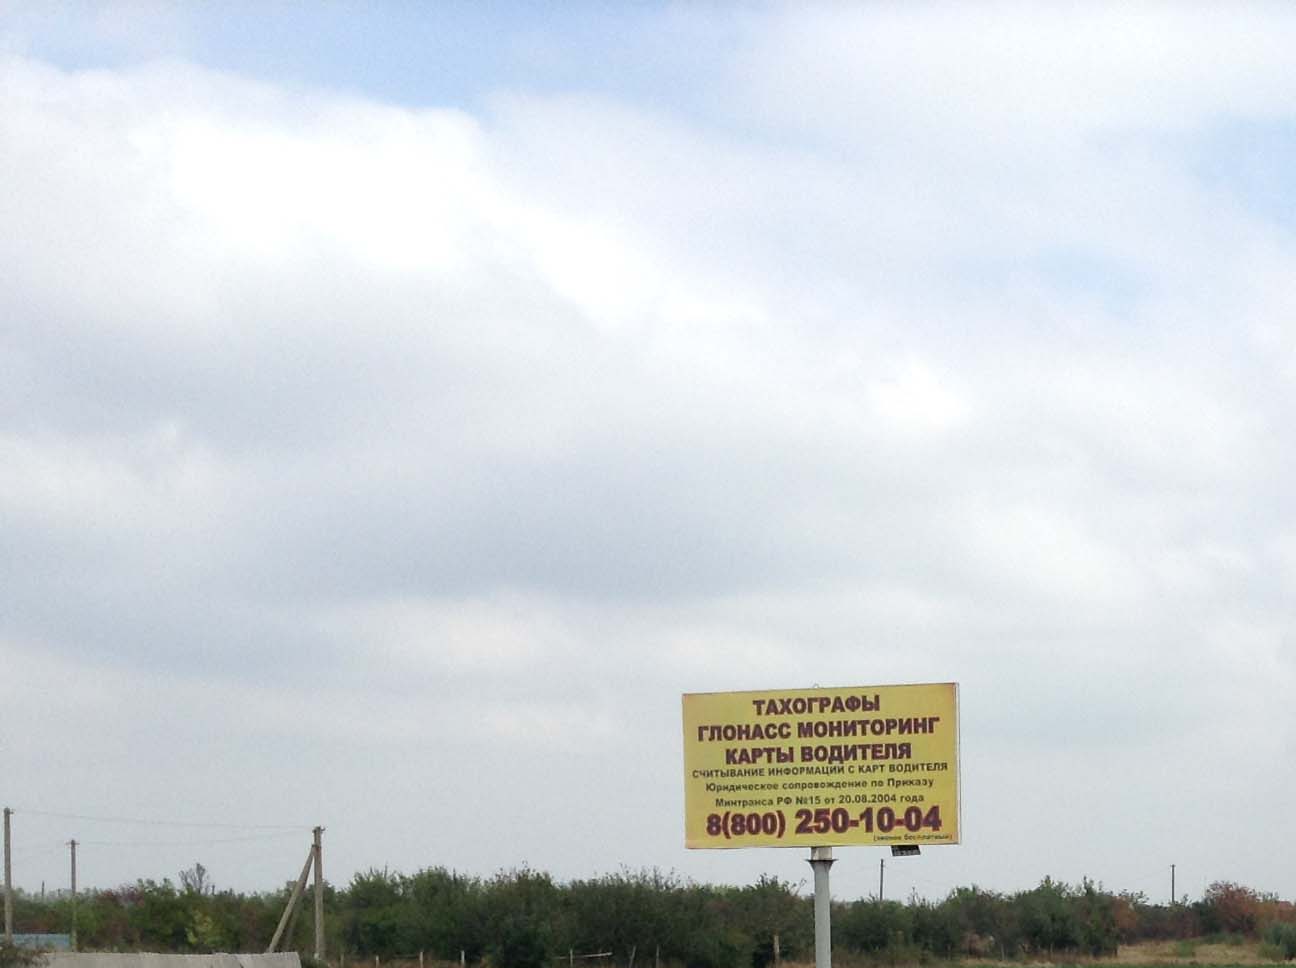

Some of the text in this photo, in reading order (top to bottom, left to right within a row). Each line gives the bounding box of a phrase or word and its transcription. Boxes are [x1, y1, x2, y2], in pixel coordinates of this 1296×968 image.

[753, 695, 880, 716] ТАХОГРАФЫ
[698, 717, 940, 742] ГЛОНАСС МОНИТОРИНГ
[726, 743, 912, 765] КАРТЫ ВОДИТЕЛЯ
[692, 762, 948, 779] СЧИТЫВАНИЕ ИНФОРМАЦИИ С КАРТ ВОДИТЕЛЯ
[705, 777, 934, 793] Юридическое сопровождение по Приказу
[715, 798, 774, 809] Минтранса
[777, 796, 793, 807] РФ
[796, 795, 821, 806] №15
[824, 795, 836, 804] от
[899, 793, 925, 804] года
[706, 805, 942, 839] 8(800) 250-10-04
